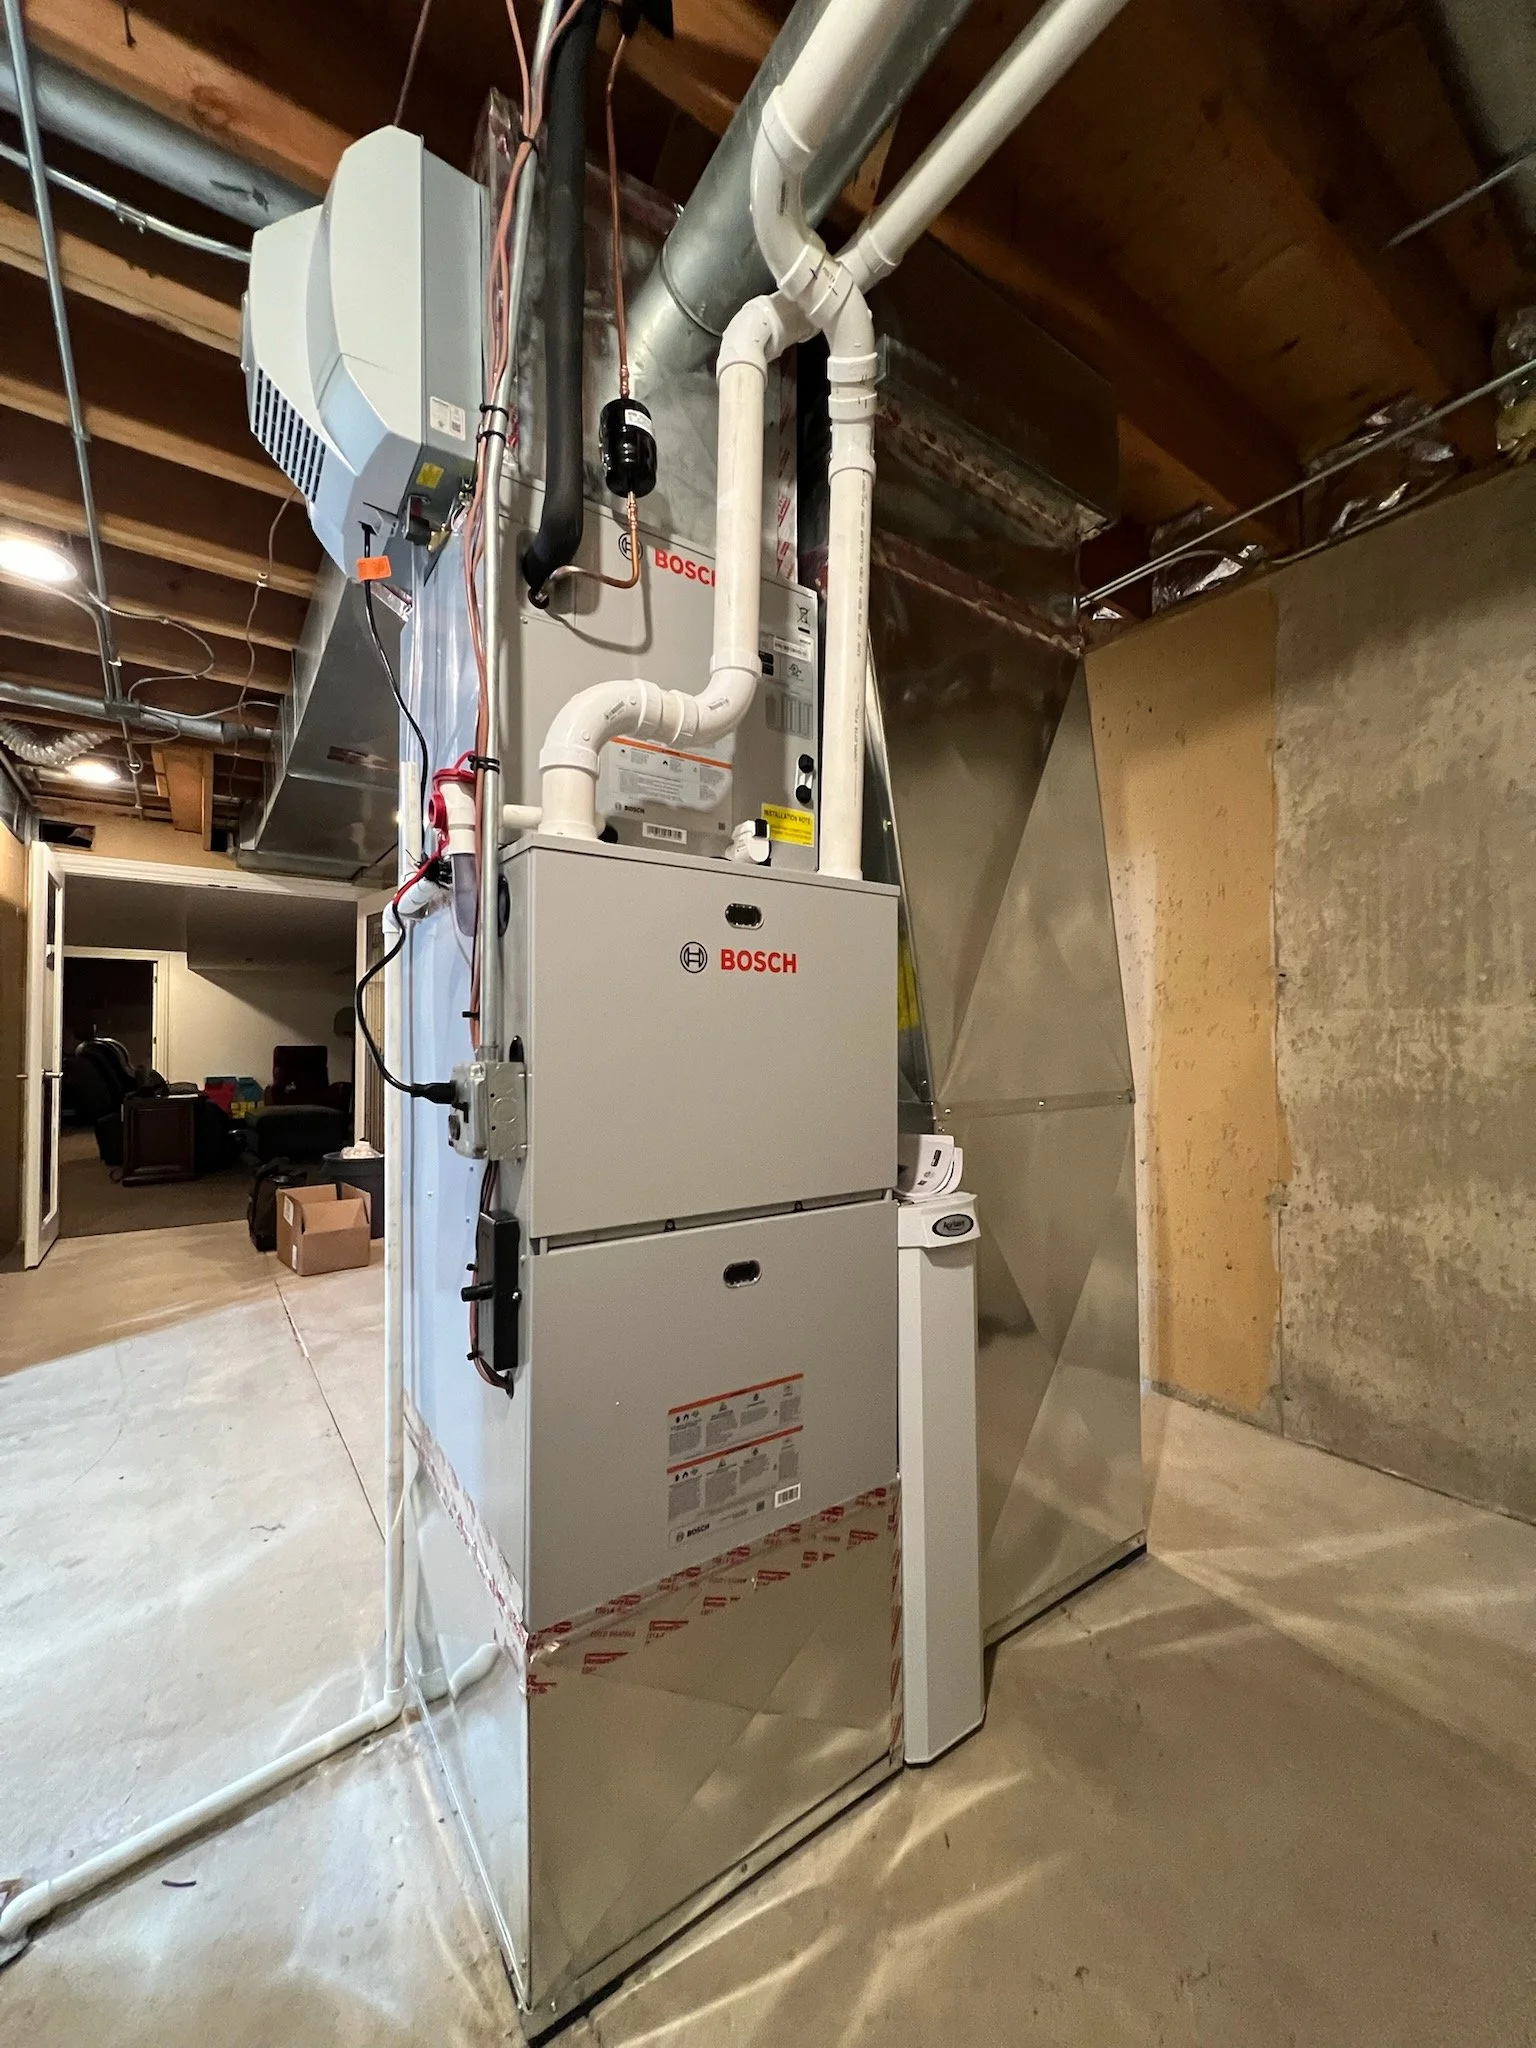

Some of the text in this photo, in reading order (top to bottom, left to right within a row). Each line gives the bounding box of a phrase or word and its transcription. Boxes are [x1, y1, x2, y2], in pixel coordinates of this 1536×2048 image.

[624, 804, 645, 814] BOSCH
[763, 809, 798, 822] INSTALLATION
[720, 949, 797, 973] BOSCH
[686, 1523, 710, 1538] BOSCH
